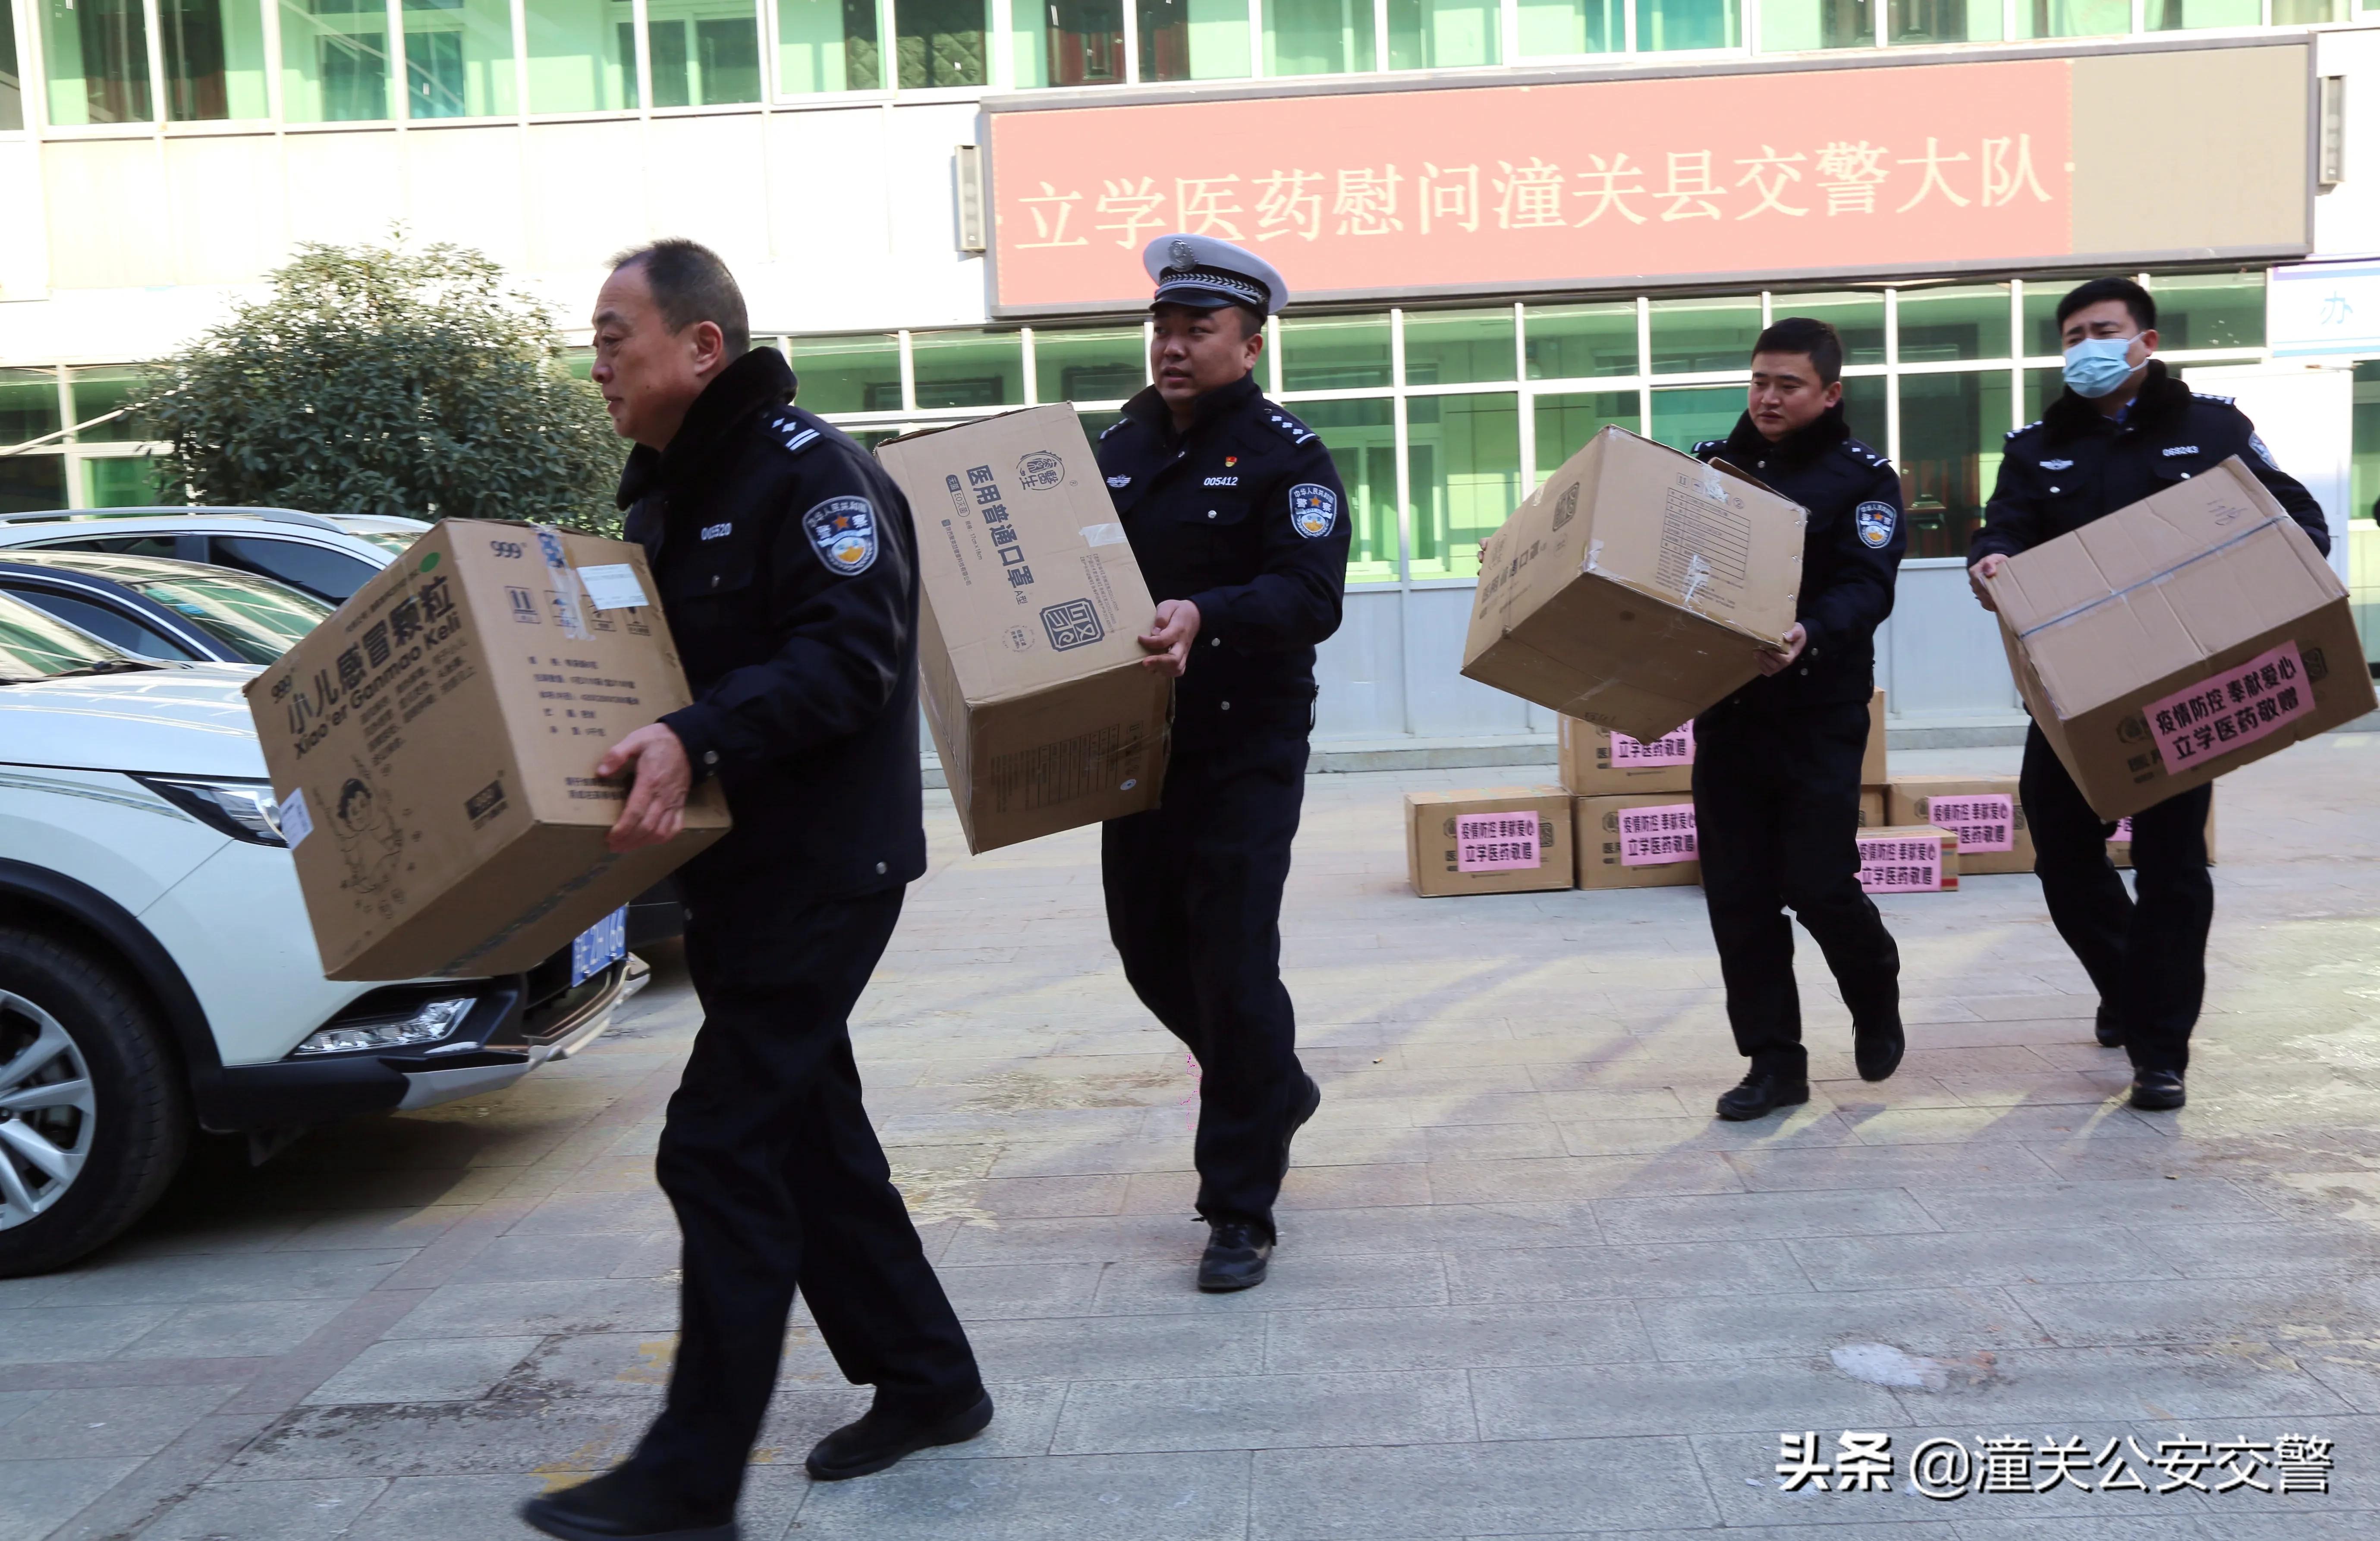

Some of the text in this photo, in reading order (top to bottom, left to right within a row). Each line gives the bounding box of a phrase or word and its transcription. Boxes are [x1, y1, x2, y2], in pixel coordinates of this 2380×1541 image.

[1014, 133, 2054, 251] 立学医药慰问潼关县交警大队
[2320, 290, 2353, 325] 办
[1203, 476, 1239, 487] 005412
[490, 540, 523, 558] 999
[966, 465, 1035, 589] 医用普通口罩
[270, 674, 293, 704] 999
[287, 575, 456, 734] 小儿感冒颗粒
[349, 646, 422, 709] Ganmao
[423, 611, 462, 651] Keli
[2156, 656, 2297, 735] 疫情防控 奉献爱心
[2172, 686, 2300, 760] 立学医药敬赠
